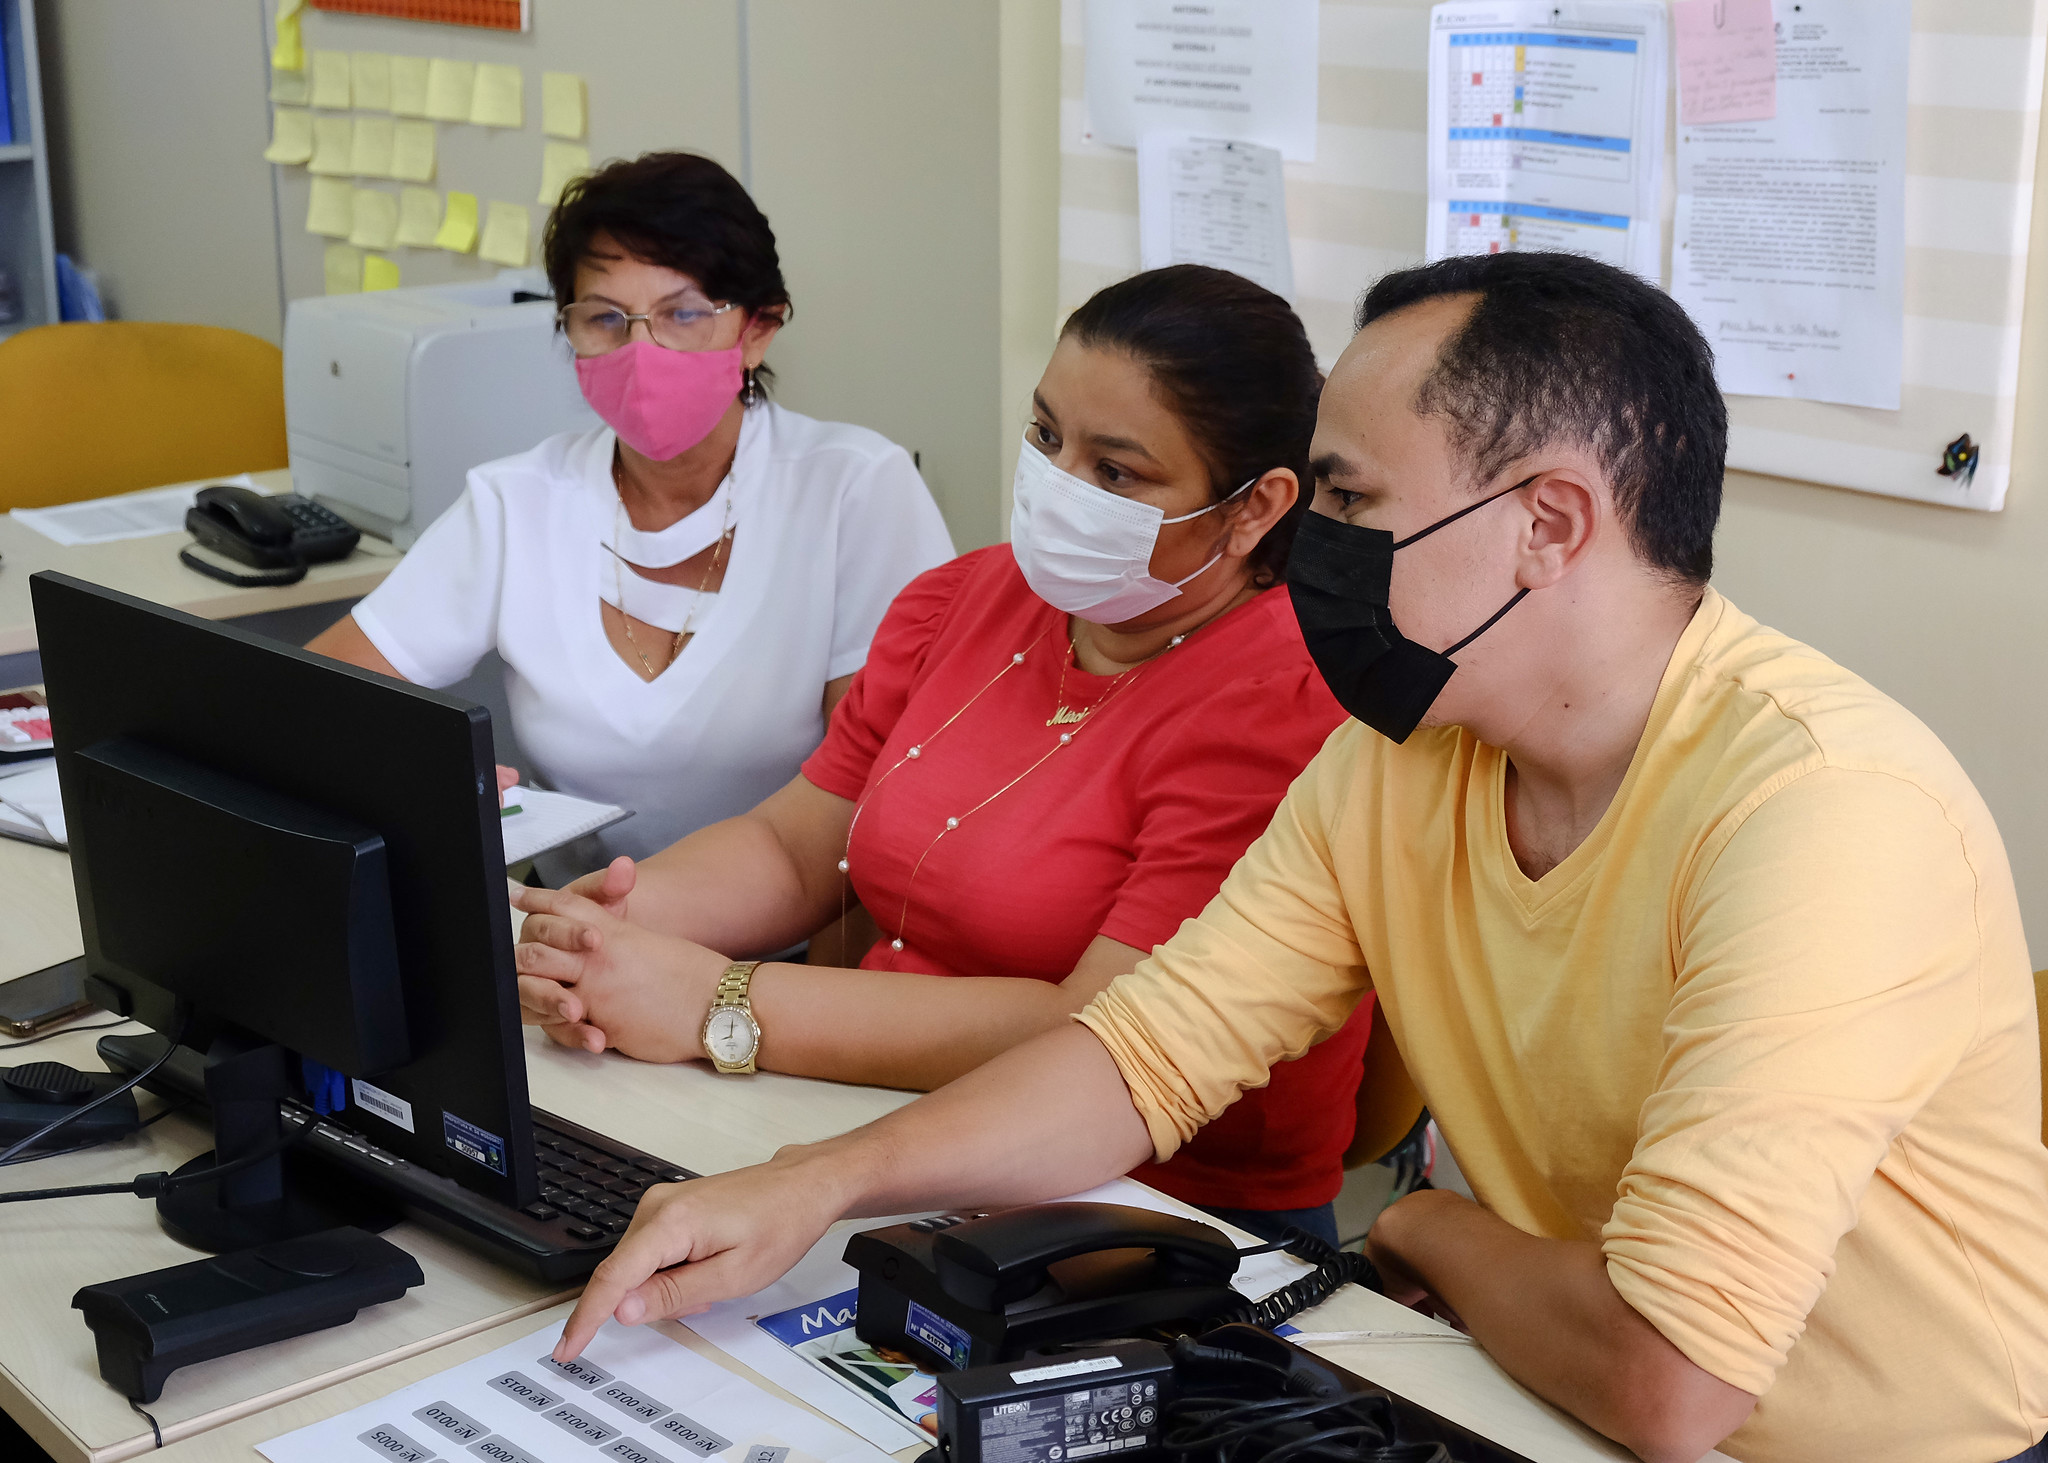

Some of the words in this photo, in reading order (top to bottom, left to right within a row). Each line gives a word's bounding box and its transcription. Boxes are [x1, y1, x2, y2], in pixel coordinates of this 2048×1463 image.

[550, 1357, 583, 1375] 00
[500, 1376, 533, 1396] 0015
[606, 1387, 640, 1408] 0019
[426, 1407, 460, 1429] 0010
[554, 1409, 589, 1430] 0014
[993, 1402, 1030, 1417] LITEON
[371, 1430, 404, 1452] 0005
[664, 1419, 699, 1442] 0018
[480, 1442, 515, 1463] 0009
[613, 1443, 648, 1463] 0013
